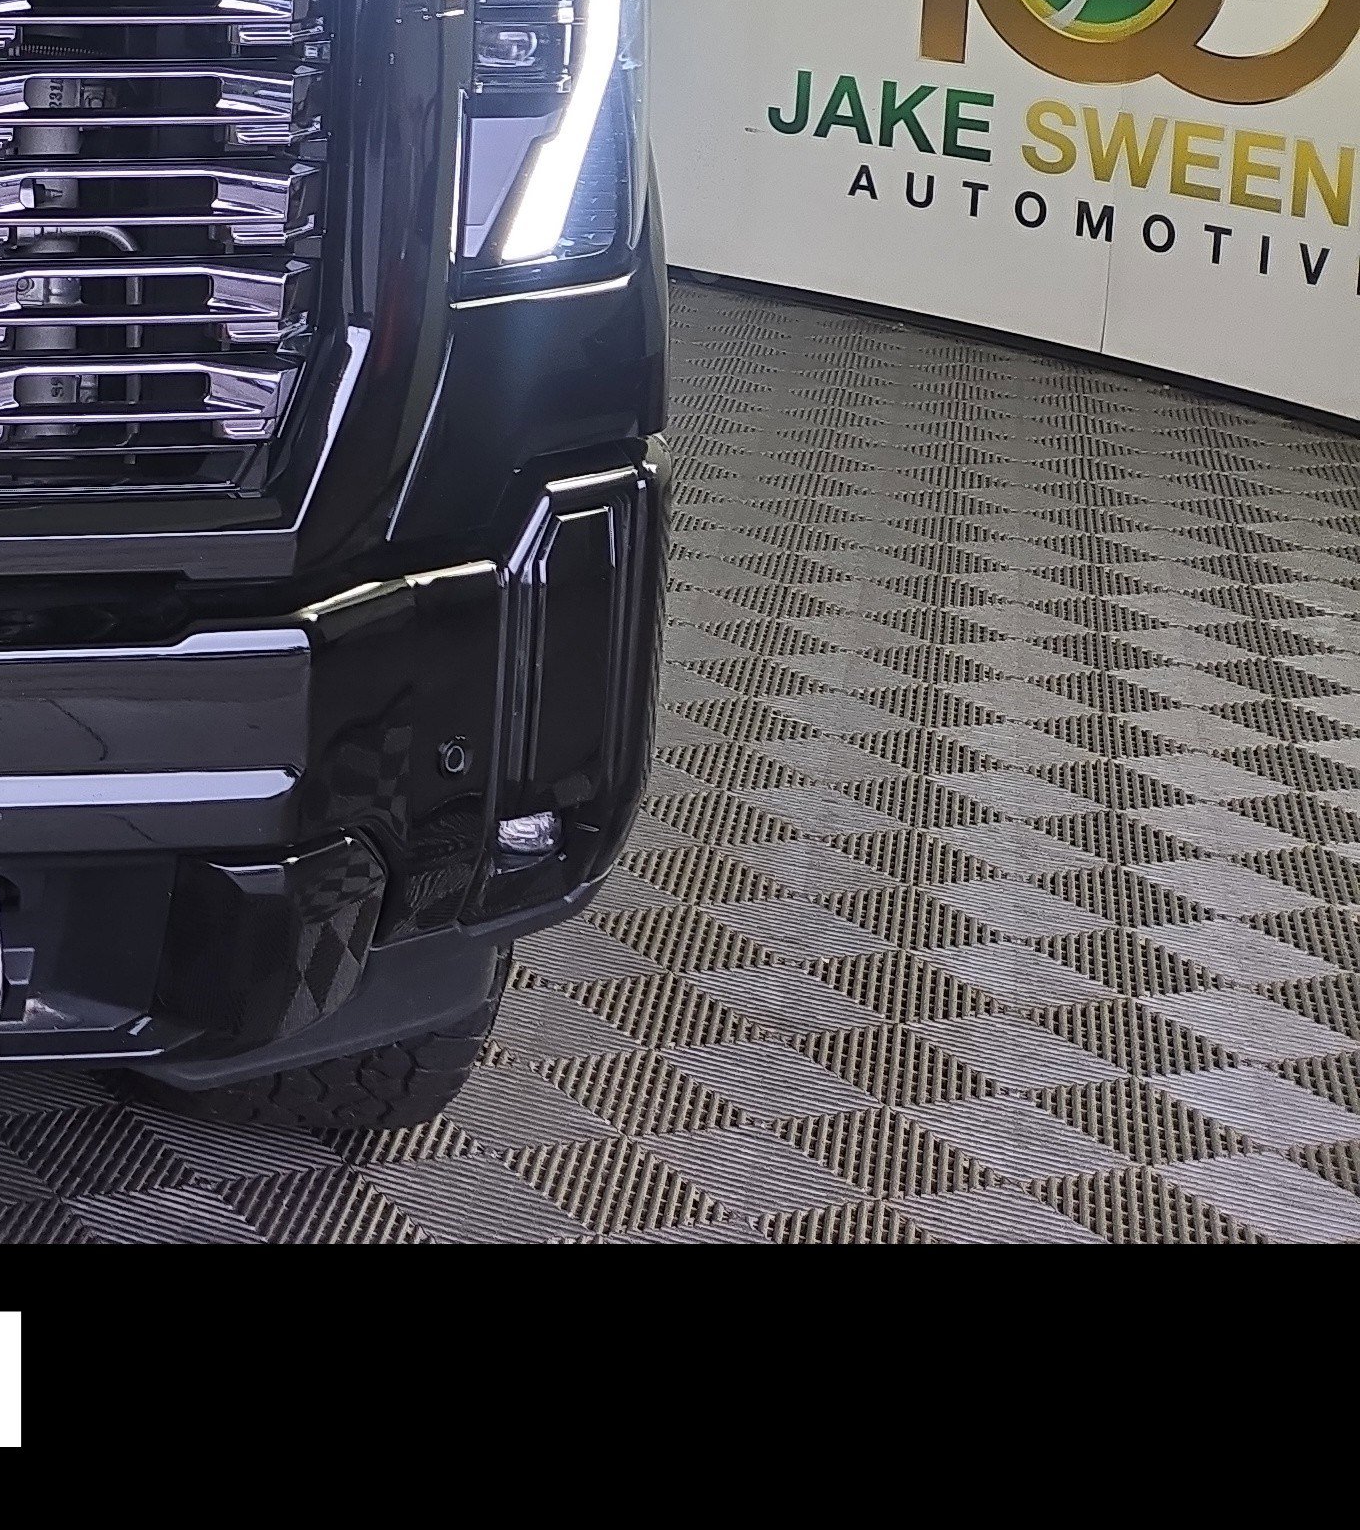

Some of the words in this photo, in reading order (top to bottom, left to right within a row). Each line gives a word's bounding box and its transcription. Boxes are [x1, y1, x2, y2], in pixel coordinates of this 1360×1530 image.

[768, 70, 996, 165] JAKE
[1021, 98, 1357, 228] SWEEN
[848, 165, 1360, 297] AUTOMOTIV
